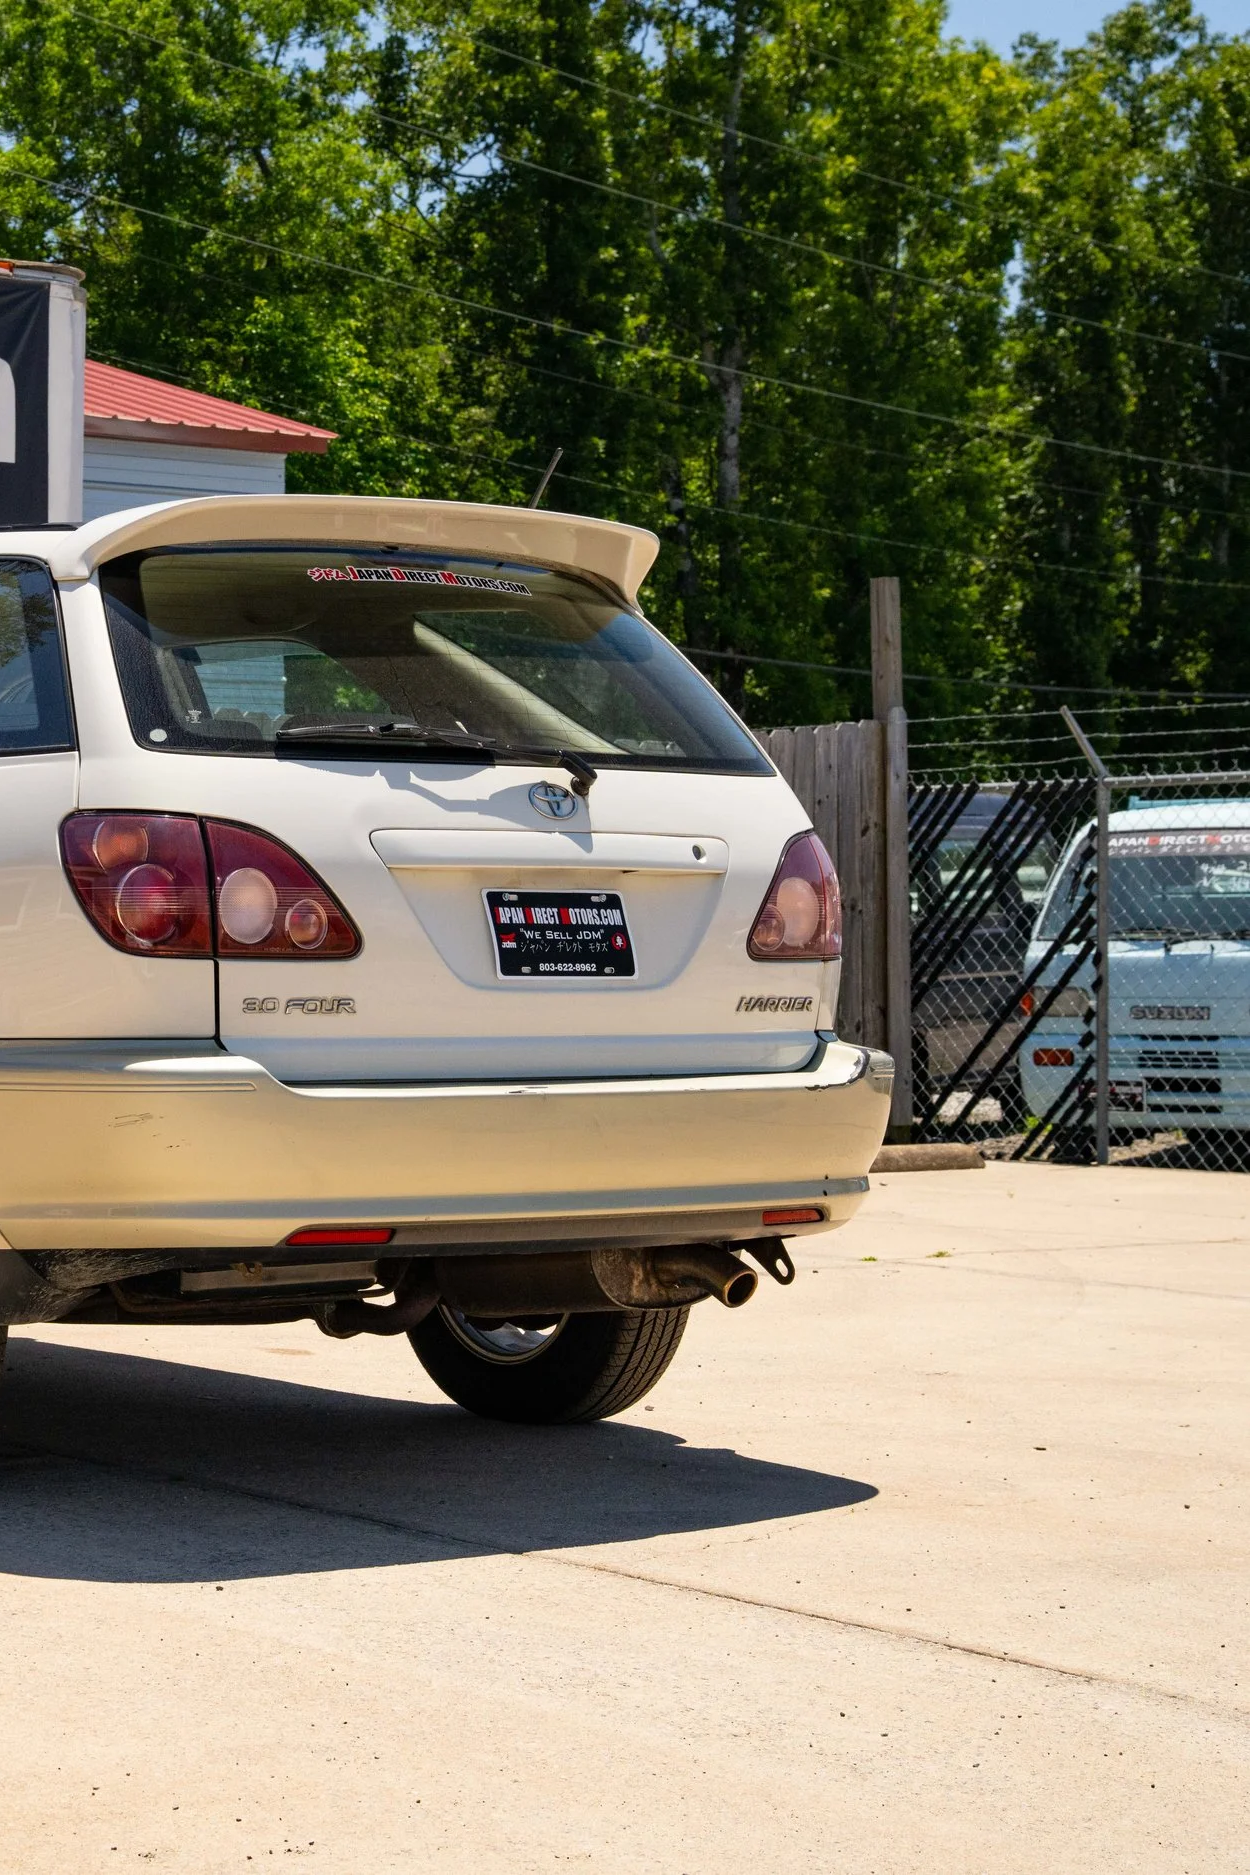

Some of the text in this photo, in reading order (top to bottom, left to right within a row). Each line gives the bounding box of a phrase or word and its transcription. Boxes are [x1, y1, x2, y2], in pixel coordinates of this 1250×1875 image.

[307, 566, 532, 596] ジドム JAPANDIRECTMOTORS.COM
[1108, 833, 1250, 847] APANDIRECTMOTO
[494, 906, 623, 926] JAPAN DIRECT MOTORS.COM
[539, 963, 597, 972] 803-622-8962
[285, 996, 356, 1014] FOUR
[735, 996, 813, 1012] HARRIER
[1129, 1005, 1211, 1020] SUZUKI
